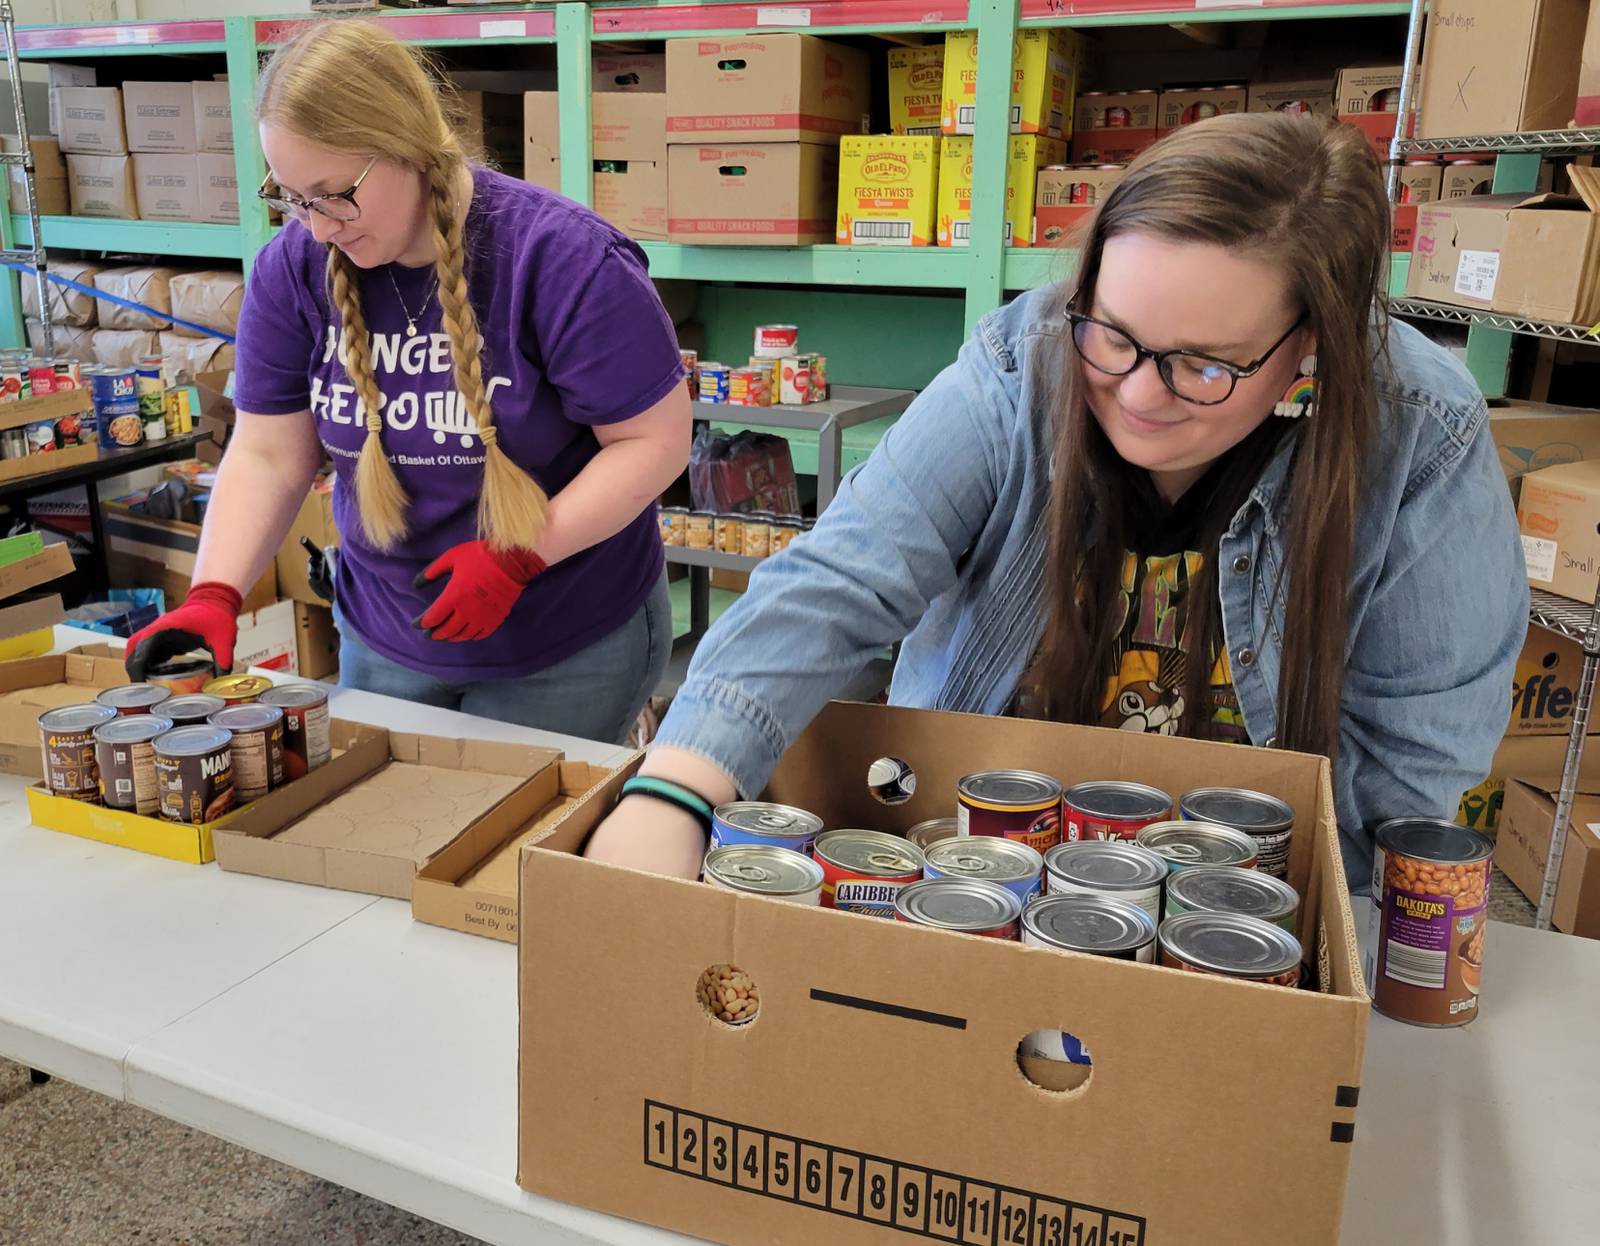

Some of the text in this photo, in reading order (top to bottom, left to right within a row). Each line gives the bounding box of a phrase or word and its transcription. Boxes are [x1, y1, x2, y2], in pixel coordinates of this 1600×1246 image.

[960, 69, 977, 81] FIES
[854, 186, 914, 199] FIESTA TWISTS
[954, 187, 972, 199] FIES
[399, 455, 436, 466] Basket
[437, 455, 451, 466] Of
[453, 455, 487, 465] Ottaw
[1561, 551, 1594, 575] Small
[201, 749, 233, 780] MAN
[837, 884, 900, 902] CARIBBE
[1396, 895, 1445, 915] DAKOTA'S
[464, 913, 485, 926] Best
[654, 1120, 665, 1154] 1
[683, 1128, 697, 1162] 2
[713, 1136, 727, 1171] 3
[743, 1144, 758, 1179] 4
[775, 1152, 789, 1186] 5
[806, 1159, 821, 1194] 6
[838, 1166, 854, 1201] 7
[870, 1174, 886, 1209] 8
[903, 1182, 919, 1218] 9
[934, 1188, 957, 1227] 10
[967, 1197, 989, 1236] 11
[1002, 1205, 1026, 1244] 12
[1037, 1214, 1061, 1246] 13
